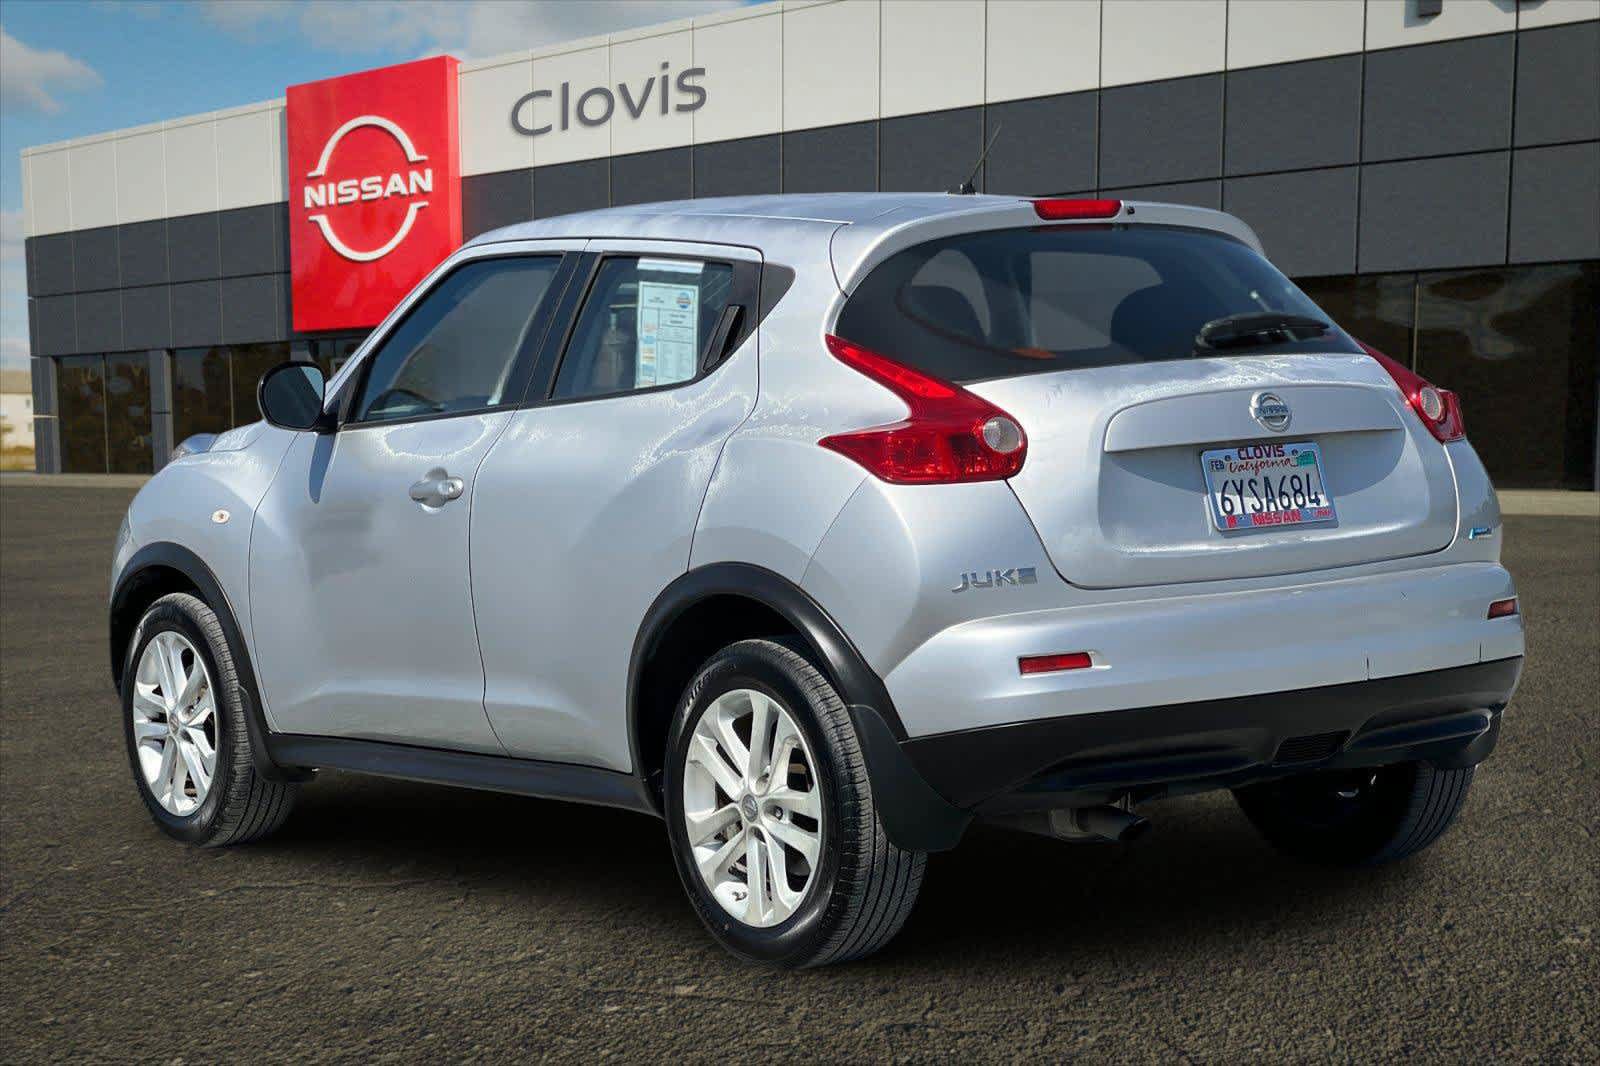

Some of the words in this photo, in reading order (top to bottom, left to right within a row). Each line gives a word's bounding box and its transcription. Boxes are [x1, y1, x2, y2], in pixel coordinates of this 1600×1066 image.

[510, 61, 707, 136] Clovis
[304, 168, 432, 208] NISSAN
[1237, 444, 1285, 461] CLOVIS
[1210, 460, 1225, 471] FEB
[1228, 458, 1299, 476] California
[1220, 472, 1321, 516] 6YSA684
[1251, 508, 1301, 526] NISSAN
[951, 567, 1037, 593] JUKE
